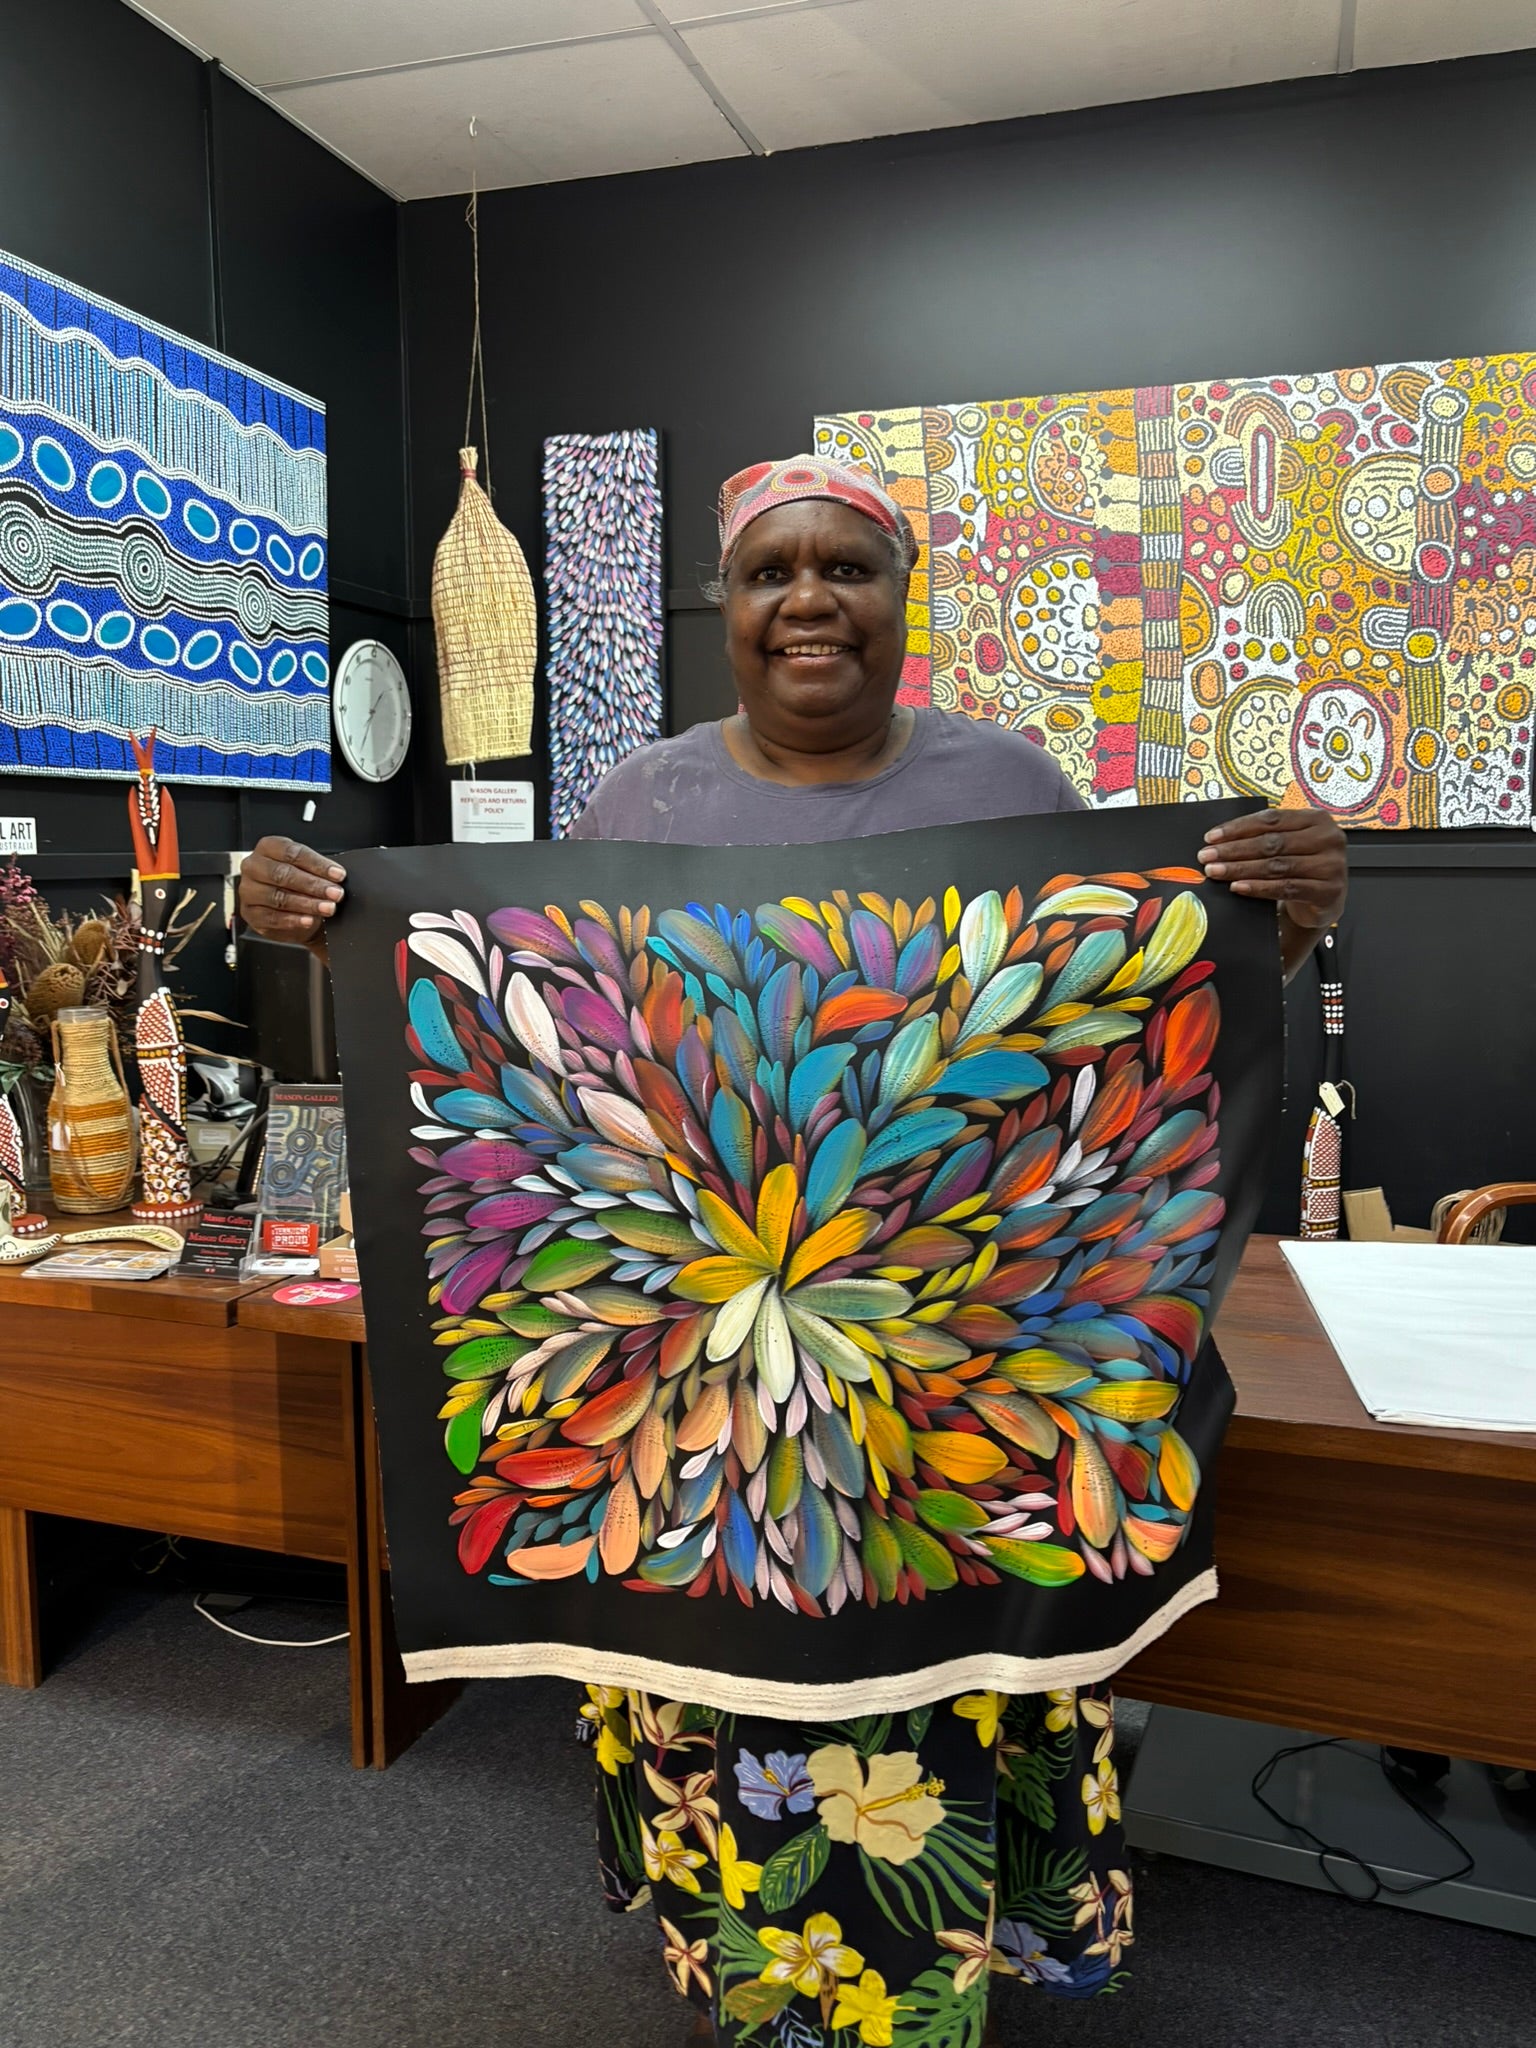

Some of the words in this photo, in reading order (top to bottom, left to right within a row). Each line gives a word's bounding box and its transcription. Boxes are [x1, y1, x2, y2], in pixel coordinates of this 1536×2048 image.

[10, 822, 32, 840] ART
[304, 1094, 338, 1102] GALLERY
[218, 1234, 247, 1246] Gallery
[274, 1235, 308, 1245] PROUD
